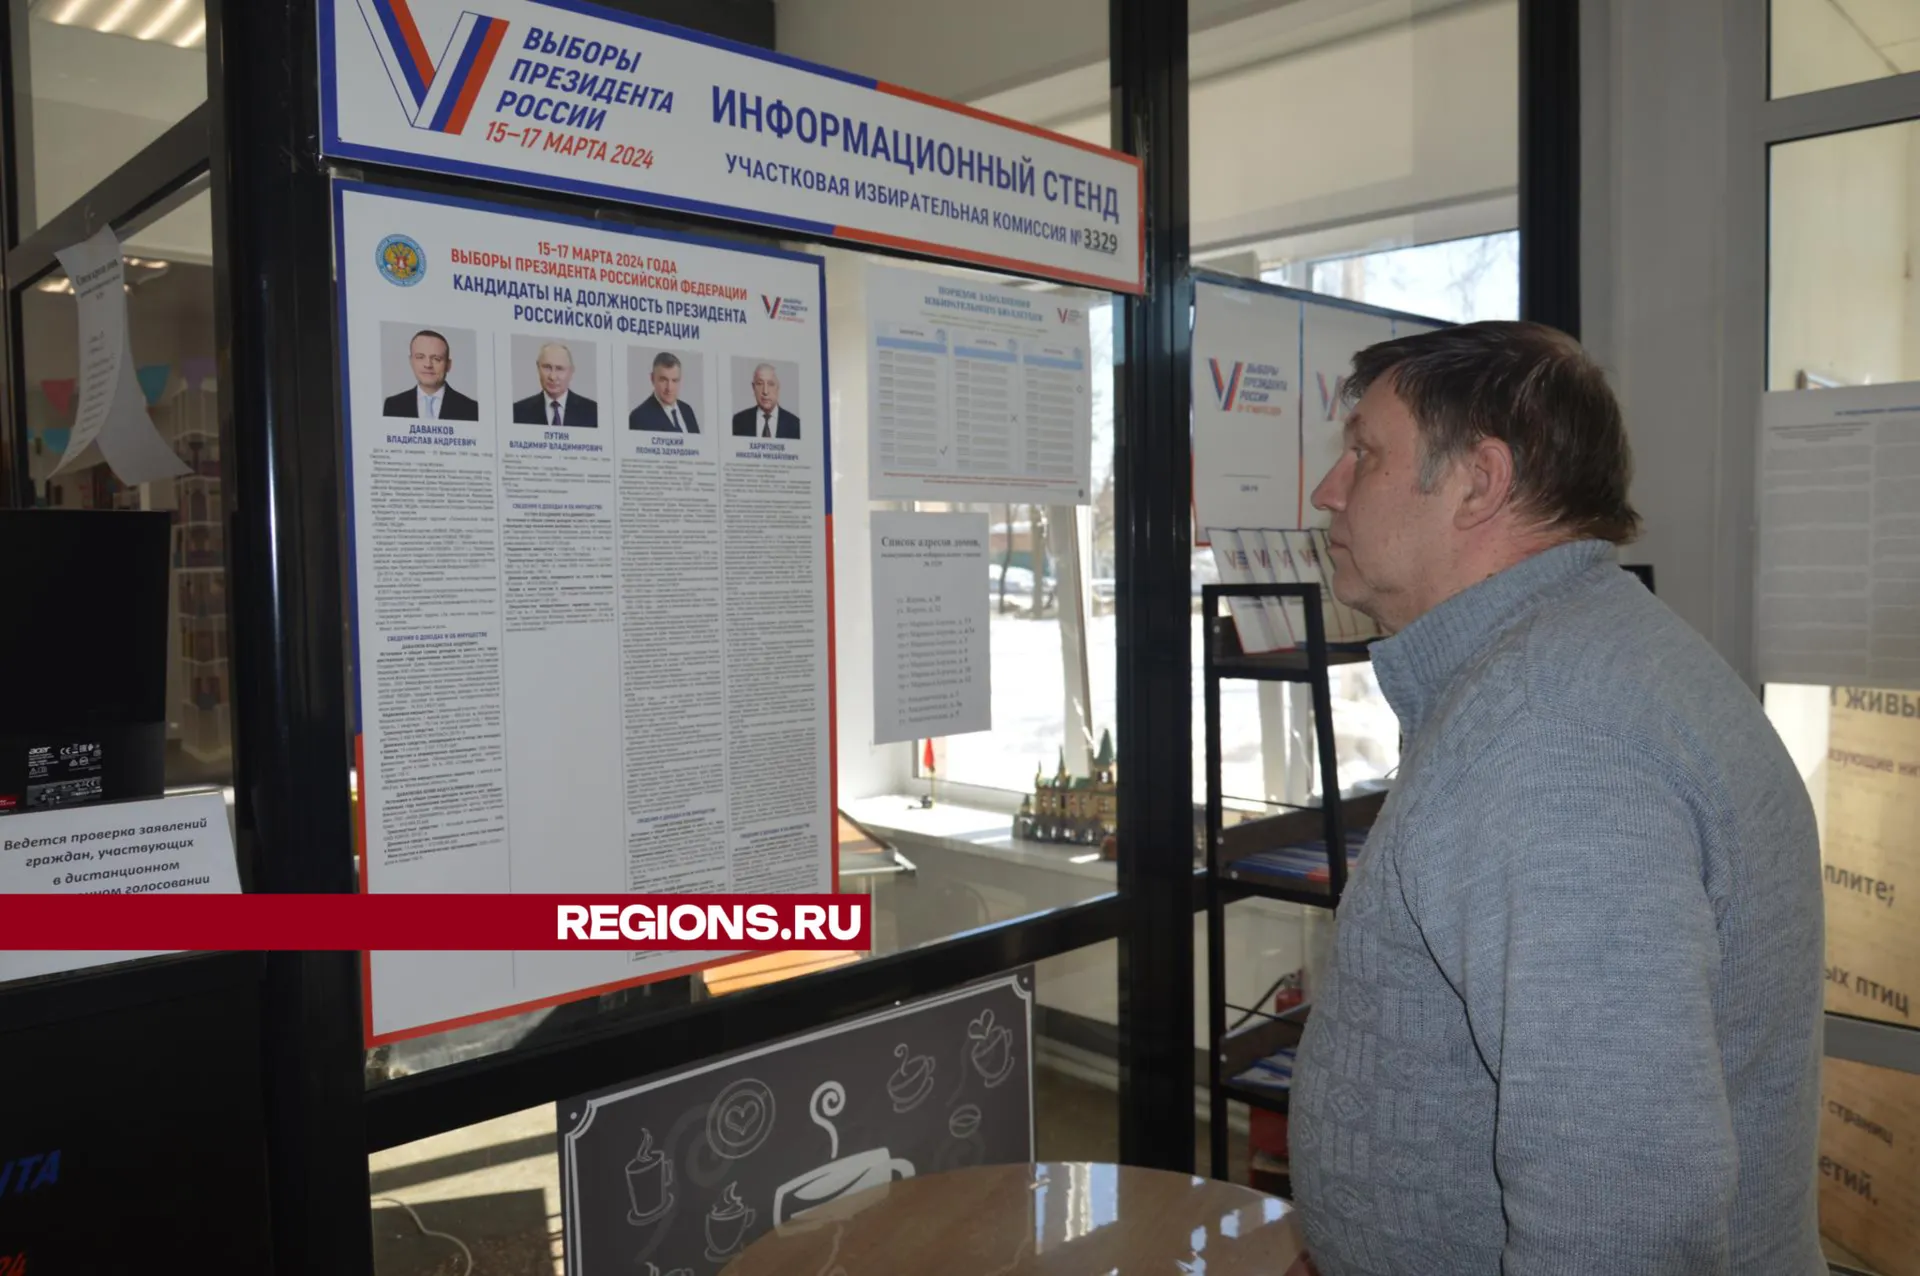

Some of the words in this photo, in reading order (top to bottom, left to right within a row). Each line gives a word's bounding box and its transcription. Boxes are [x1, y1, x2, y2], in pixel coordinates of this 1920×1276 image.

[523, 27, 642, 74] ВЫБОРЫ
[510, 59, 675, 113] ПРЕЗИДЕНТА
[496, 90, 608, 131] РОССИИ
[543, 132, 608, 161] МАРТА
[610, 145, 654, 169] 2024
[712, 85, 1036, 197] ИНФОРМАЦИОННЫЙ
[1043, 170, 1120, 224] СТЕНД
[725, 153, 850, 197] УЧАСТКОВАЯ
[855, 179, 990, 227] ИЗБИРАТЕЛЬНАЯ
[993, 212, 1067, 244] КОМИССИЯ
[451, 248, 512, 271] ВЫБОРЫ
[514, 255, 597, 282] ПРЕЗИДЕНТА
[600, 267, 678, 292] РОССИЙСКОЙ
[680, 277, 748, 301] ФЕДЕРАЦИИ
[572, 246, 614, 266] МАРТА
[616, 252, 643, 269] 2024
[646, 256, 678, 275] ГОДА
[452, 274, 549, 303] КАНДИДАТЫ
[553, 285, 572, 303] НА
[576, 289, 663, 316] ДОЛЖНОСТЬ
[666, 299, 747, 325] ПРЕЗИДЕНТА
[513, 303, 613, 333] РОССИЙСКОЙ
[616, 314, 701, 341] ФЕДЕРАЦИИ
[386, 435, 433, 446] ВЛАДИСЛАВ
[434, 437, 477, 447] АНДРЕЕВИЧ
[409, 424, 454, 436] ДАВАНКОВ
[544, 431, 569, 441] ПУТИН
[651, 436, 684, 447] СЛУЦКИЙ
[509, 440, 548, 450] ВЛАДИМИР
[549, 441, 603, 452] ВЛАДИМИРОВИЧ
[636, 446, 661, 455] ЛЕОНИД
[662, 447, 700, 457] ЭДУАРДОВИЧ
[735, 451, 762, 460] НИКОЛАЙ
[749, 442, 785, 451] ХАРИТОНОВ
[880, 536, 916, 548] Список
[918, 538, 951, 550] адресов
[4, 833, 67, 851] Ведется
[70, 827, 136, 844] проверка
[139, 818, 208, 836] заявлений
[25, 849, 94, 869] граждан,
[98, 838, 194, 860] участвующих
[52, 877, 61, 886] в
[65, 860, 180, 885] дистанционном
[125, 875, 210, 894] голосовании
[1824, 864, 1895, 908] плите;
[1856, 976, 1910, 1019] птиц
